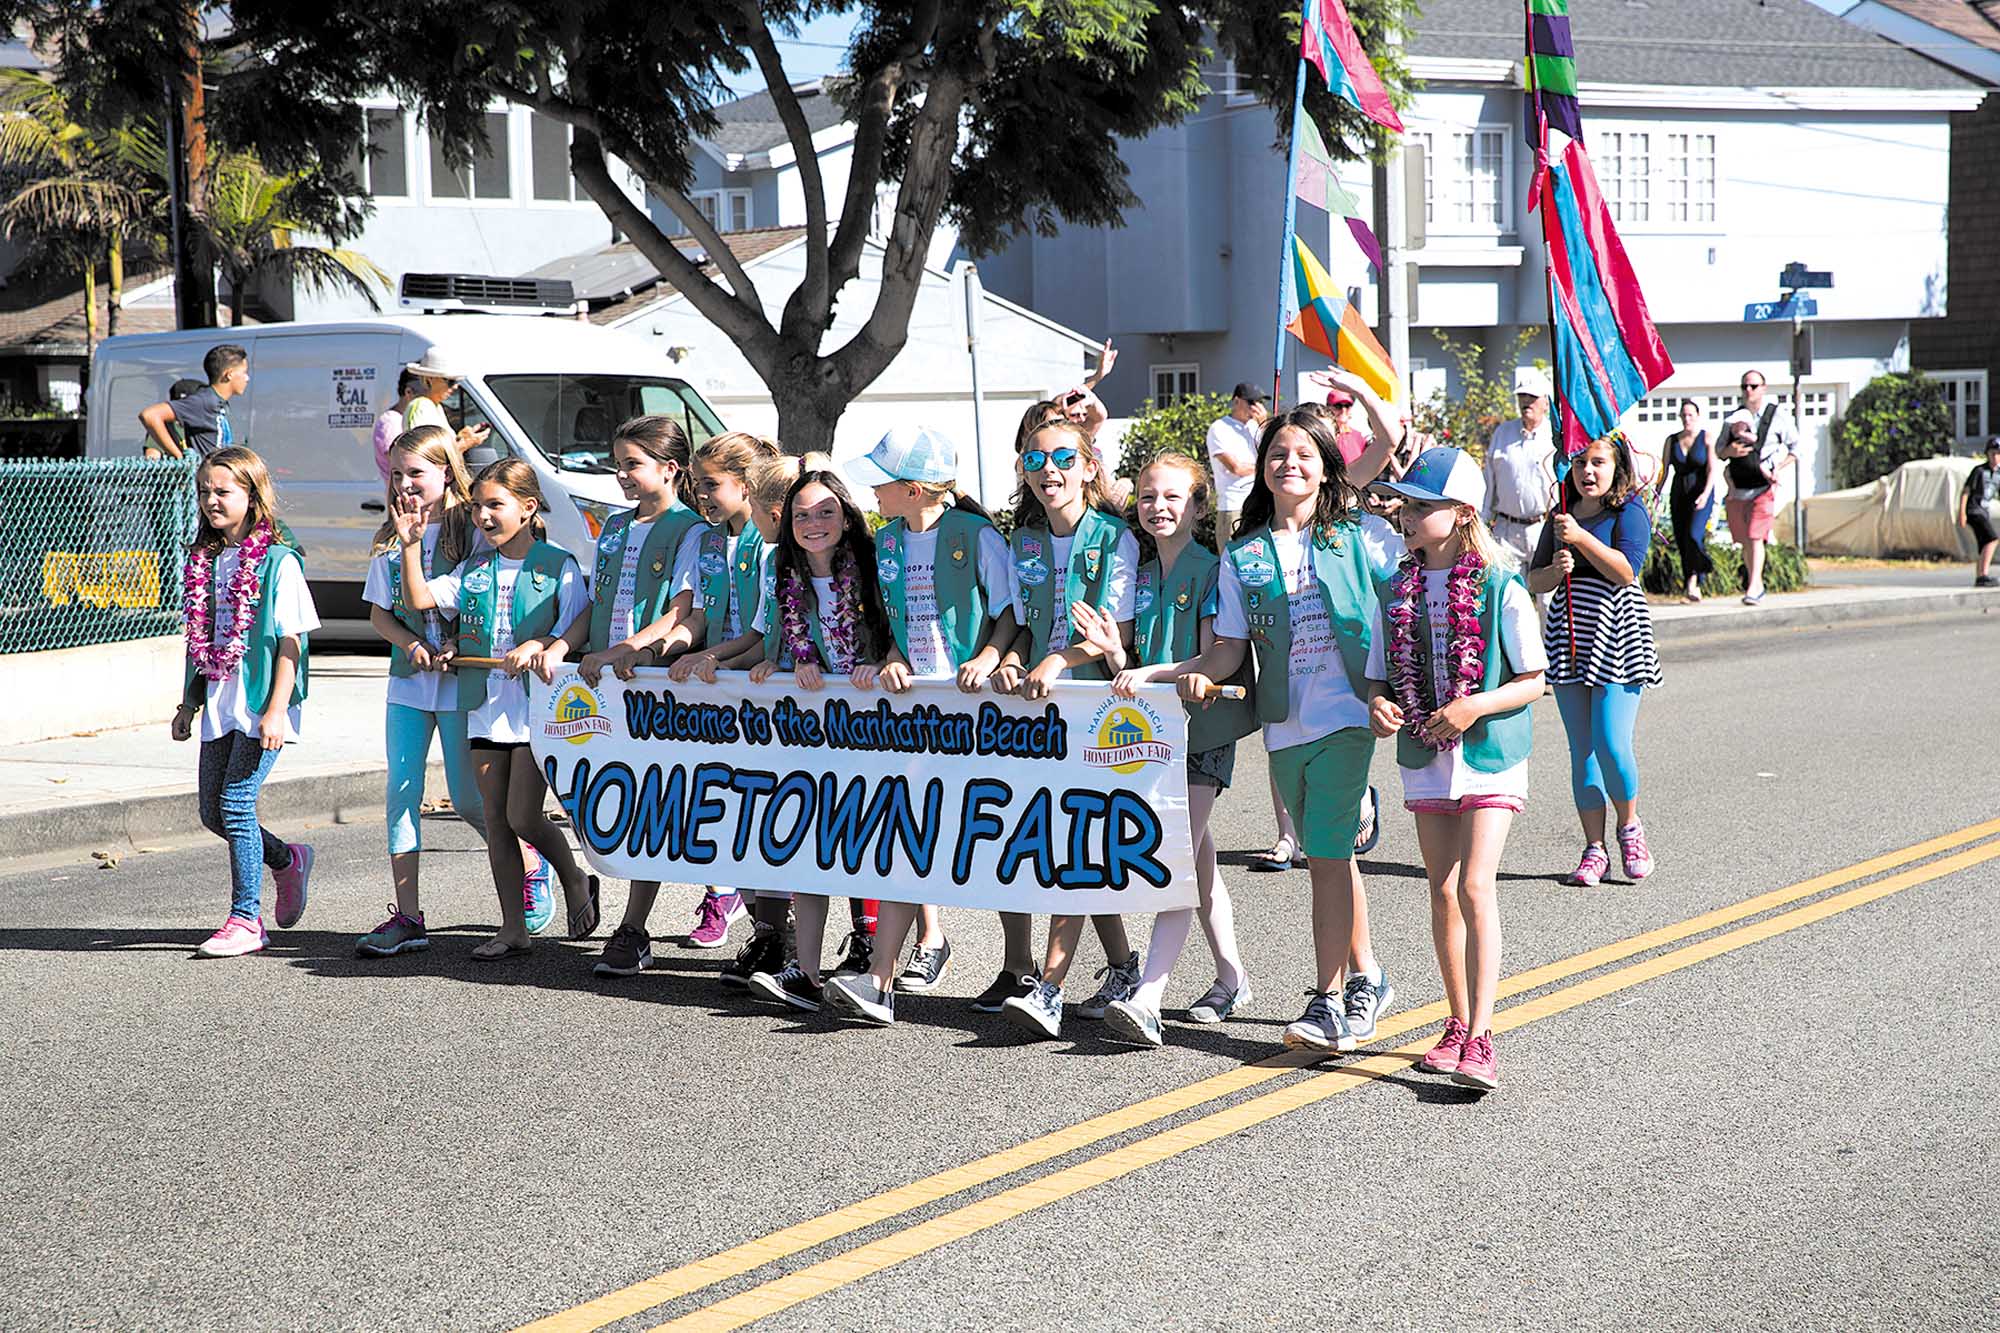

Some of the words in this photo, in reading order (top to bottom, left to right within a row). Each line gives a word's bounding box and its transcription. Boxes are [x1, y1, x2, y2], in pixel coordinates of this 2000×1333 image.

[1754, 304, 1772, 320] 20
[340, 388, 369, 406] CAL
[623, 689, 740, 745] Welcome
[738, 698, 772, 746] to
[770, 695, 826, 748] the
[825, 698, 974, 756] Manhattan
[976, 701, 1069, 761] Beach
[1137, 698, 1165, 735] BEACH
[544, 720, 591, 737] HOMETOWN
[592, 719, 612, 734] FAIR
[1083, 745, 1144, 764] HOMETOWN
[1147, 745, 1172, 761] FAIR
[544, 755, 944, 879] HOMETOWN
[951, 777, 1172, 892] FAIR
